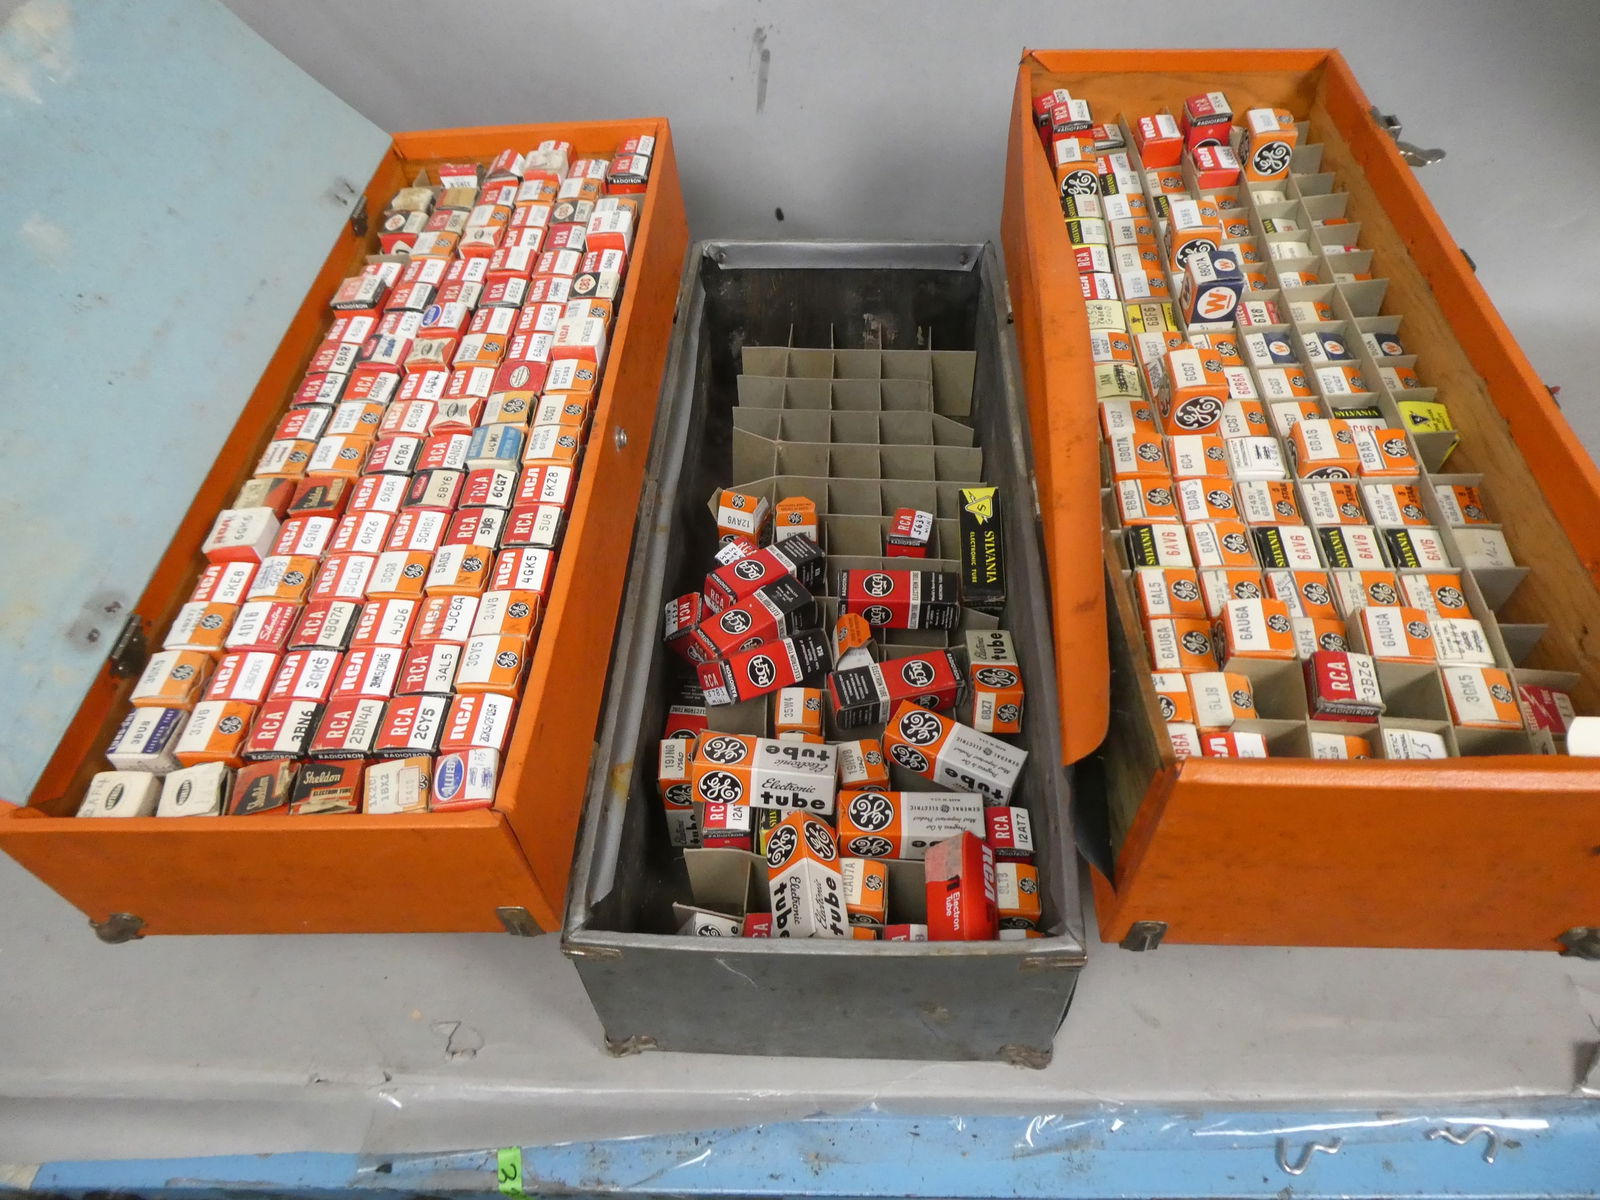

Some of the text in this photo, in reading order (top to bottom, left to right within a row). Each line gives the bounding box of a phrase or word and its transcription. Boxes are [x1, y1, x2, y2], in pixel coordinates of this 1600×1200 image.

[1140, 117, 1156, 138] RCA
[1196, 117, 1229, 126] RADIOTRON
[1198, 148, 1215, 167] RCA
[1077, 252, 1090, 267] RCA
[1196, 257, 1212, 278] 6BQ7A
[1080, 276, 1091, 298] RCA
[472, 308, 488, 331] RCA
[520, 306, 536, 329] RCA
[1250, 308, 1266, 324] 6X8
[510, 336, 526, 358] RCA
[1306, 341, 1321, 358] 6AL5
[354, 376, 375, 393] RCA
[400, 374, 420, 398] RCA
[450, 370, 466, 394] RCA
[1232, 373, 1250, 394] 6CB6A
[284, 414, 306, 433] RCA
[1335, 409, 1378, 417] SYLVANIA
[370, 444, 390, 465] RCA
[394, 444, 412, 466] 6T8A
[427, 442, 447, 462] RCA
[1116, 436, 1132, 464] 6BQ7A
[1180, 454, 1194, 470] 6C4
[354, 478, 377, 508] RCA
[380, 480, 397, 503] 6X8A
[436, 476, 453, 498] 6BY6
[471, 476, 490, 498] RCA
[492, 473, 508, 498] 6CG7
[522, 468, 540, 498] RCA
[543, 472, 559, 496] 6KZ8
[334, 516, 357, 549] RCA
[360, 520, 380, 545] 6HZ6
[390, 514, 412, 547] RCA
[457, 516, 478, 538] RCA
[514, 512, 534, 534] RCA
[538, 514, 552, 532] 5U8
[727, 515, 750, 528] 12AV6
[898, 514, 912, 532] RCA
[913, 514, 924, 536] 5639
[278, 520, 301, 555] RCA
[1140, 528, 1156, 566] SYLVANIA
[1162, 531, 1181, 556] 6AV6
[1196, 531, 1214, 554] 6AV6
[1266, 530, 1286, 568] SYLVANIA
[1290, 534, 1312, 560] 6AV6
[1329, 530, 1348, 568] SYLVANIA
[1352, 534, 1374, 560] 6AV6
[1396, 532, 1417, 568] SYLVANIA
[1420, 538, 1442, 562] 6AV6
[496, 552, 516, 586] RCA
[984, 530, 998, 584] SYLVANIA
[194, 565, 222, 600] RCA
[316, 560, 342, 594] RCA
[522, 556, 538, 584] 4GK5
[739, 561, 760, 580] RCA
[871, 574, 884, 596] RCA
[1149, 582, 1164, 606] 6AL5
[302, 610, 326, 637] RCA
[322, 606, 346, 640] 4BQ7A
[356, 602, 380, 640] RCA
[390, 608, 409, 636] 4JD6
[420, 598, 444, 635] RCA
[446, 597, 466, 632] 4JC6A
[680, 602, 691, 623] RCA
[724, 611, 746, 633] RCA
[870, 605, 884, 626] RCA
[1236, 606, 1253, 640] 6AU6A
[1157, 626, 1175, 659] 6AU6A
[1376, 612, 1396, 648] 6AU6A
[974, 636, 988, 660] Electronic
[987, 632, 1008, 661] tube
[211, 654, 240, 695] RCA
[274, 654, 302, 694] RCA
[306, 656, 330, 690] 3GK5
[340, 652, 367, 690] RCA
[409, 655, 429, 684] RCA
[435, 653, 452, 682] 3AL5
[753, 656, 770, 686] RCA
[788, 655, 802, 682] ELECTRON
[871, 665, 884, 688] ELECTRON
[912, 661, 928, 686] RCA
[946, 653, 960, 680] RADIOTRON
[1327, 662, 1350, 692] RCA
[1356, 660, 1376, 697] 3BZ6
[704, 673, 720, 687] RCA
[726, 664, 738, 698] RADIOTRON
[1458, 674, 1481, 704] 3GK5
[450, 696, 476, 740] RCA
[784, 698, 794, 718] 35W4
[981, 700, 992, 720] 6BZ7
[1324, 706, 1375, 717] RADIOTRON
[257, 711, 285, 740] RCA
[291, 710, 314, 744] 3BN6
[326, 710, 352, 739] RCA
[349, 704, 376, 745] 2BN4A
[390, 706, 416, 736] RCA
[414, 708, 436, 740] 2CY5
[664, 744, 676, 768] 19JN8
[765, 745, 830, 761] tube
[774, 758, 828, 772] Electronic
[303, 770, 341, 785] Sheldon
[440, 761, 458, 799] ALLIED
[762, 777, 816, 794] Electronic
[944, 768, 1004, 800] tube
[760, 791, 825, 810] tube
[994, 816, 1010, 840] RCA
[1018, 814, 1028, 844] 12AT7
[982, 844, 996, 902] RCA
[790, 876, 801, 925] Electronic
[814, 878, 828, 930] Electronic
[824, 876, 844, 936] tube
[952, 891, 960, 932] Electron
